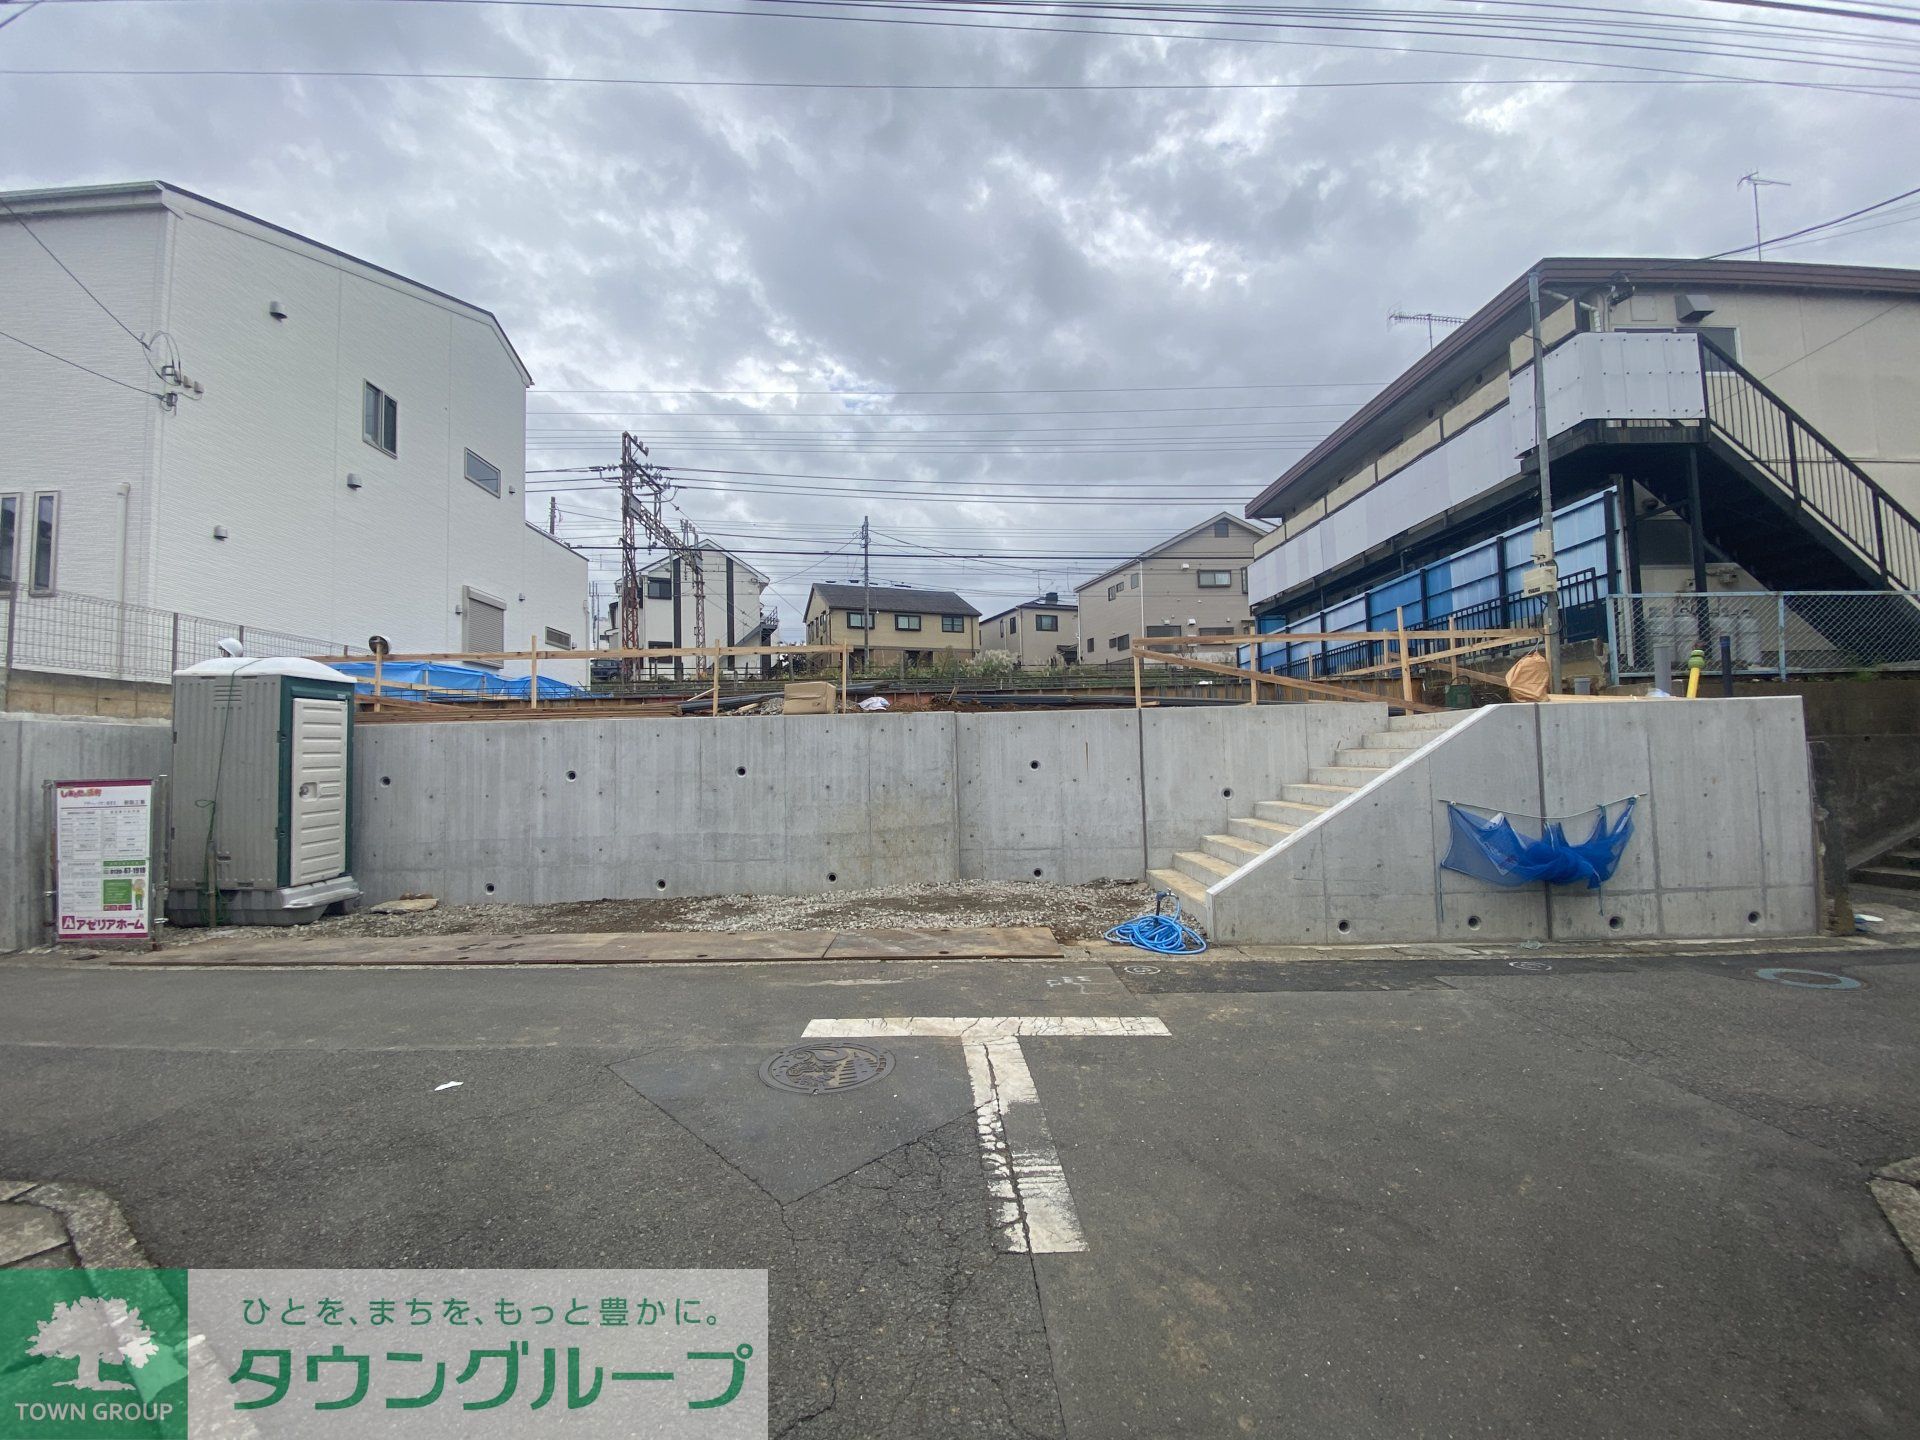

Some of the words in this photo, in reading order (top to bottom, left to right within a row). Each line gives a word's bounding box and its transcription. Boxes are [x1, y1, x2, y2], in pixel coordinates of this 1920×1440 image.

[76, 919, 144, 930] アゼリアホーム
